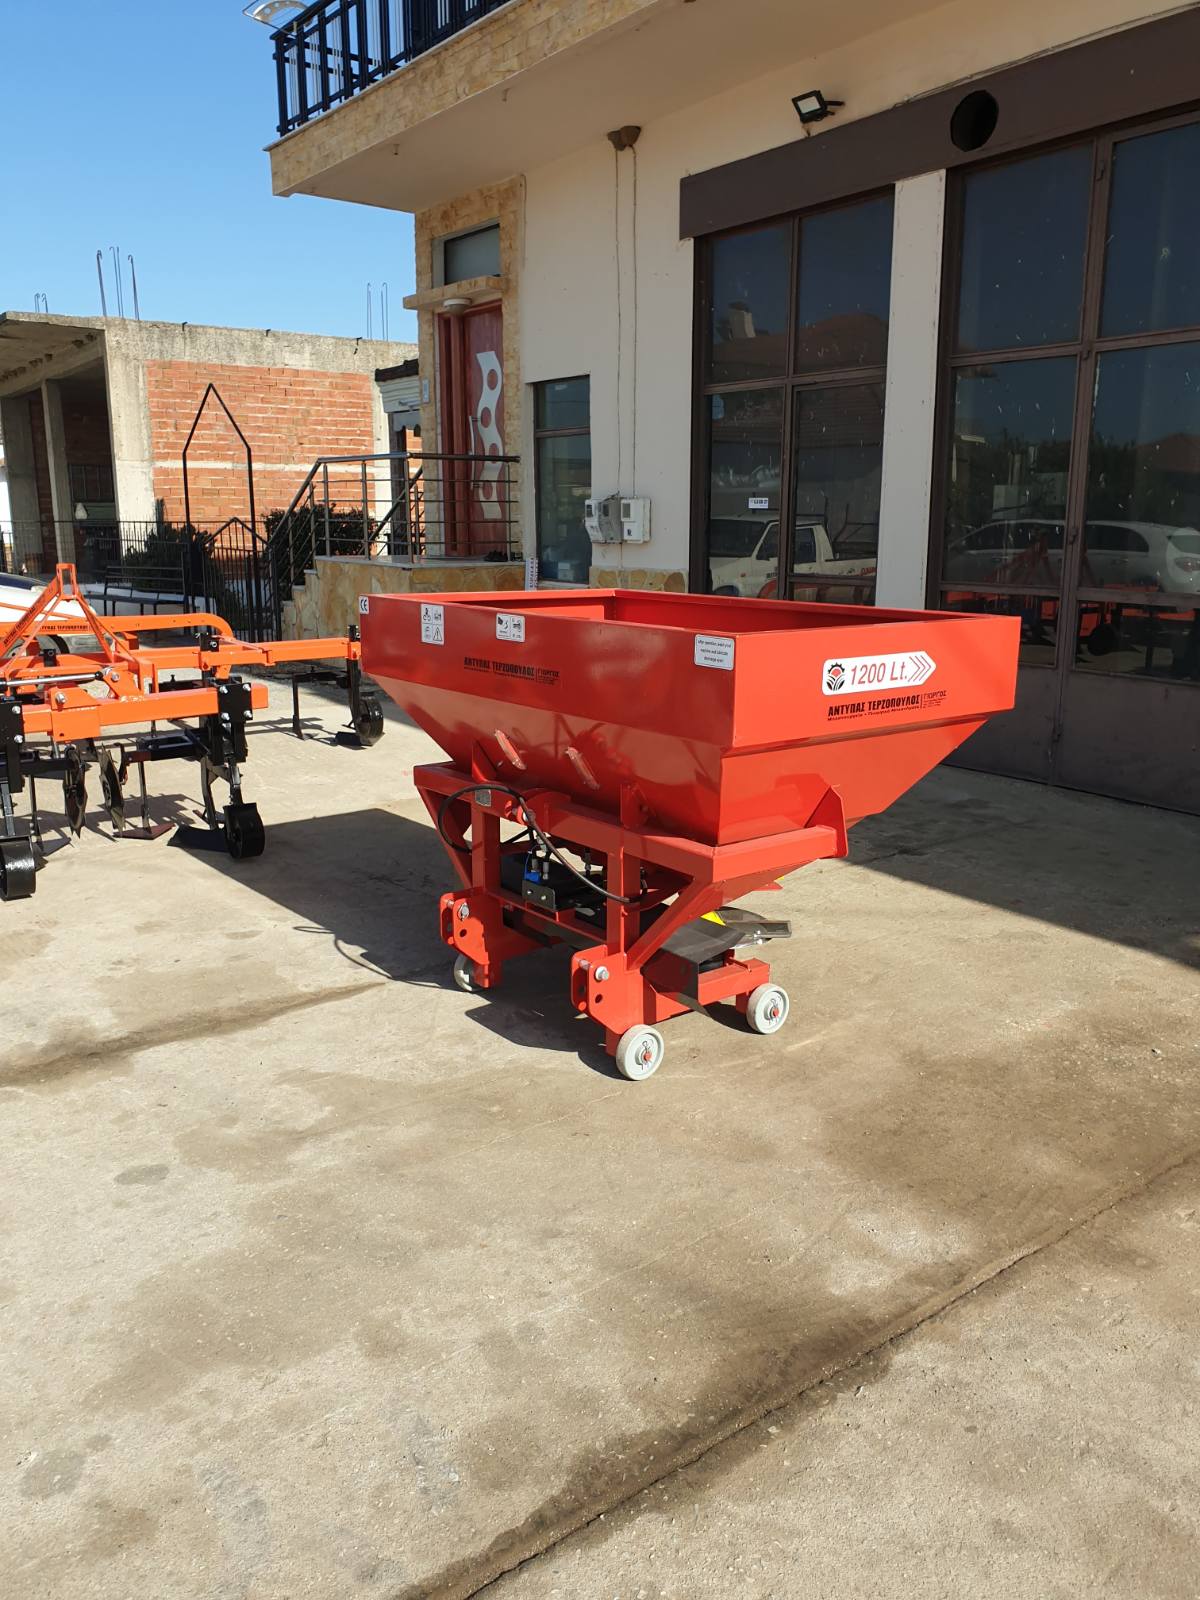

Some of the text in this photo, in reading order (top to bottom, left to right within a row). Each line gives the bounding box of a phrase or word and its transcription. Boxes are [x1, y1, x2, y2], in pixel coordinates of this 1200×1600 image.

[360, 599, 368, 612] CE
[492, 661, 535, 677] ΤΕΡΖΟΠΟΥΛΟΣ
[851, 661, 907, 686] 1200 Lt.
[828, 702, 866, 717] ΑΝΤΥΠΑΣ
[868, 694, 921, 711] ΤΕΡΖΟΠΟΥΛΟΣ
